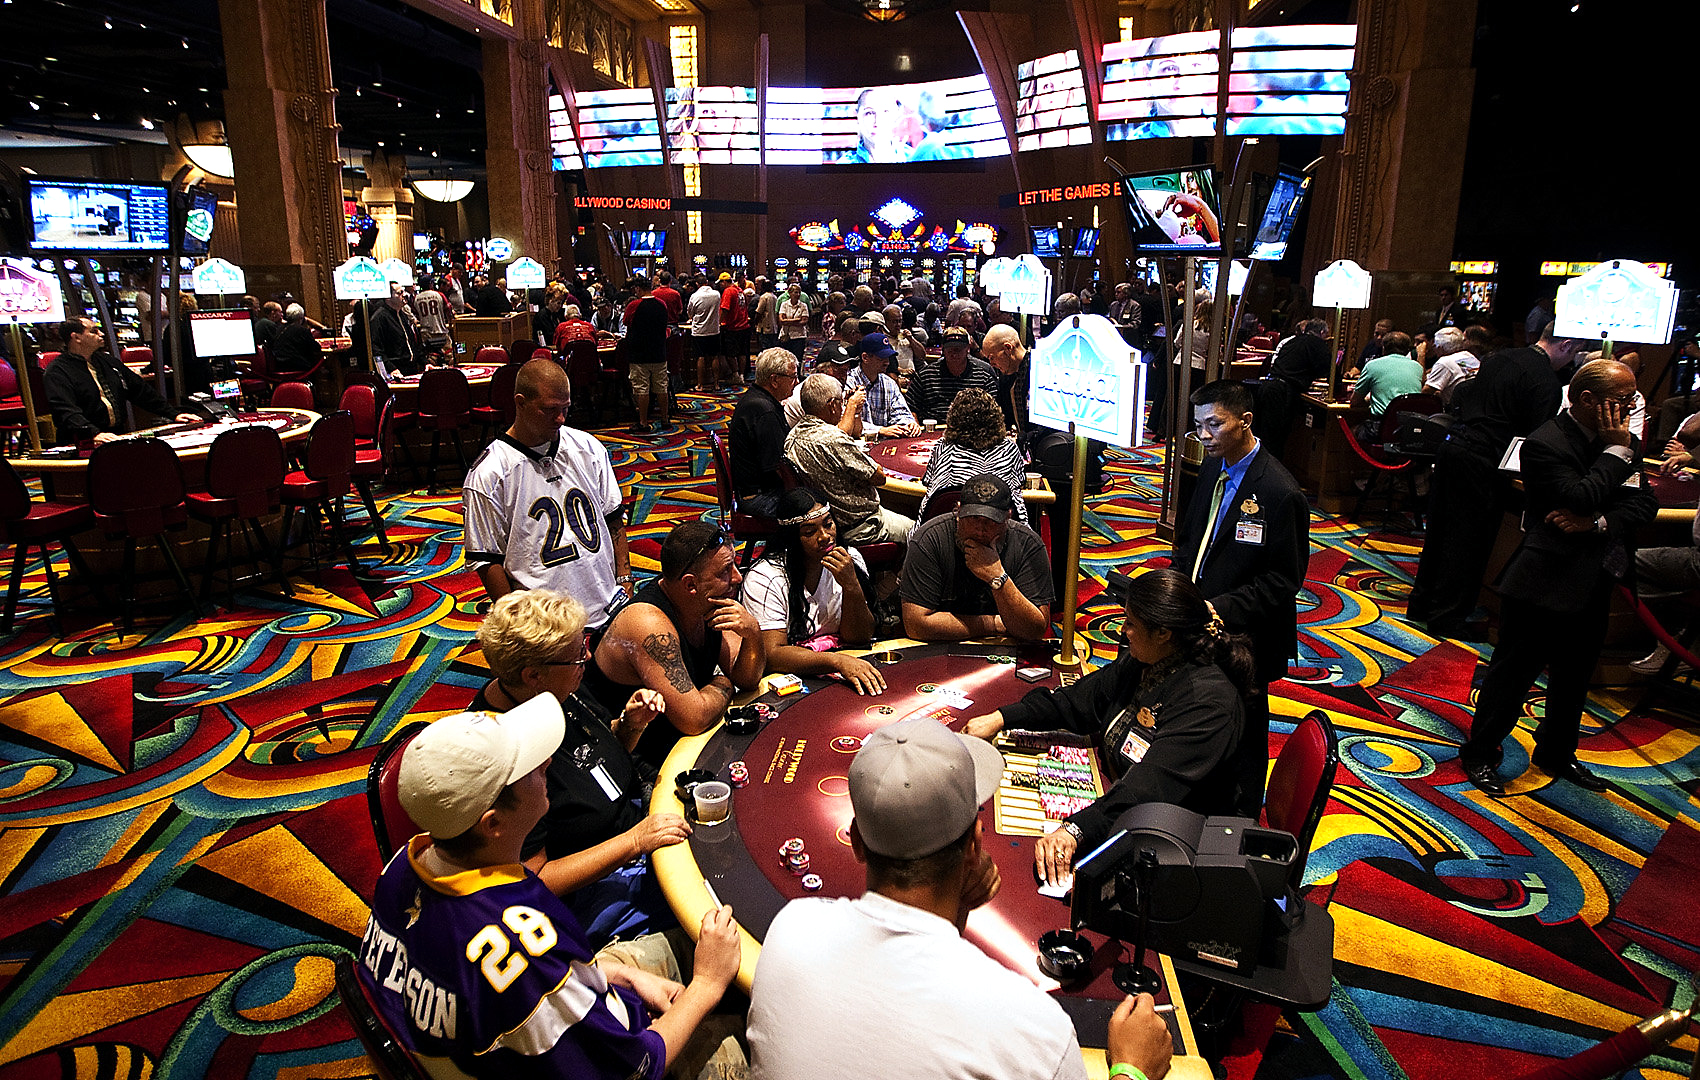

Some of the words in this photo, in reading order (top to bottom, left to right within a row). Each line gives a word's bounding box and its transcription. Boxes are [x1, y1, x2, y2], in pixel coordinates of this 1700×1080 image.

[625, 197, 671, 210] CASINO!
[1019, 191, 1038, 206] LET
[1040, 187, 1062, 203] THE
[1064, 183, 1111, 200] GAMES
[528, 487, 601, 569] 20
[466, 905, 558, 993] 28
